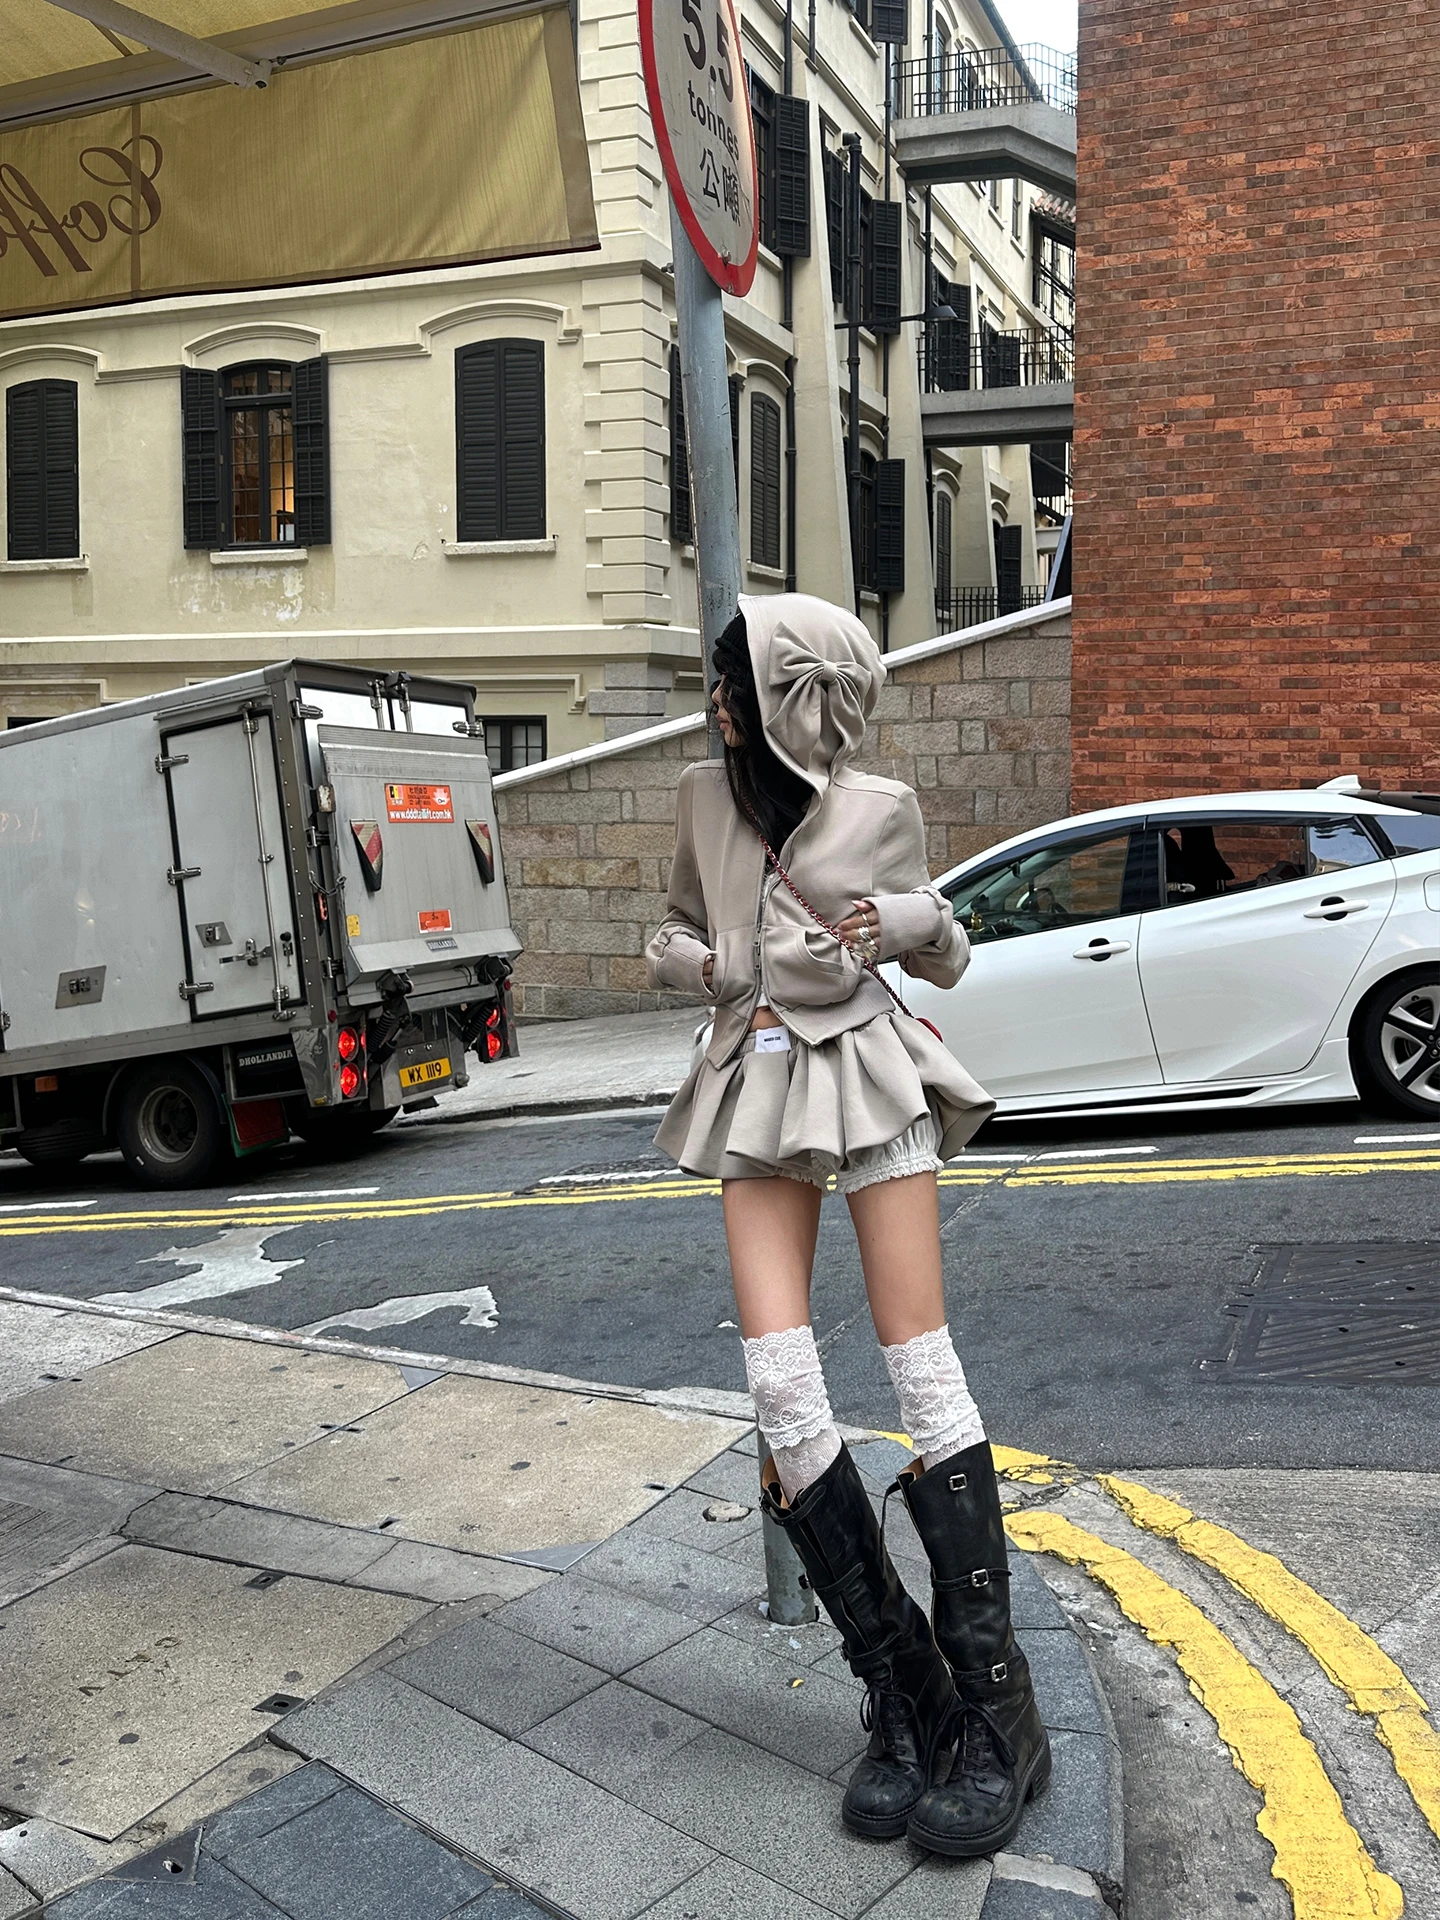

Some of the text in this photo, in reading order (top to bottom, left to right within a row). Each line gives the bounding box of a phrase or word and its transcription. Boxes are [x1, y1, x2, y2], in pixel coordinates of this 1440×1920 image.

[682, 0, 734, 103] 5.5
[687, 79, 740, 162] tonnes
[700, 147, 741, 227] 公噸
[239, 1050, 293, 1067] DHOLLANDIA
[408, 1062, 442, 1084] WX 1119
